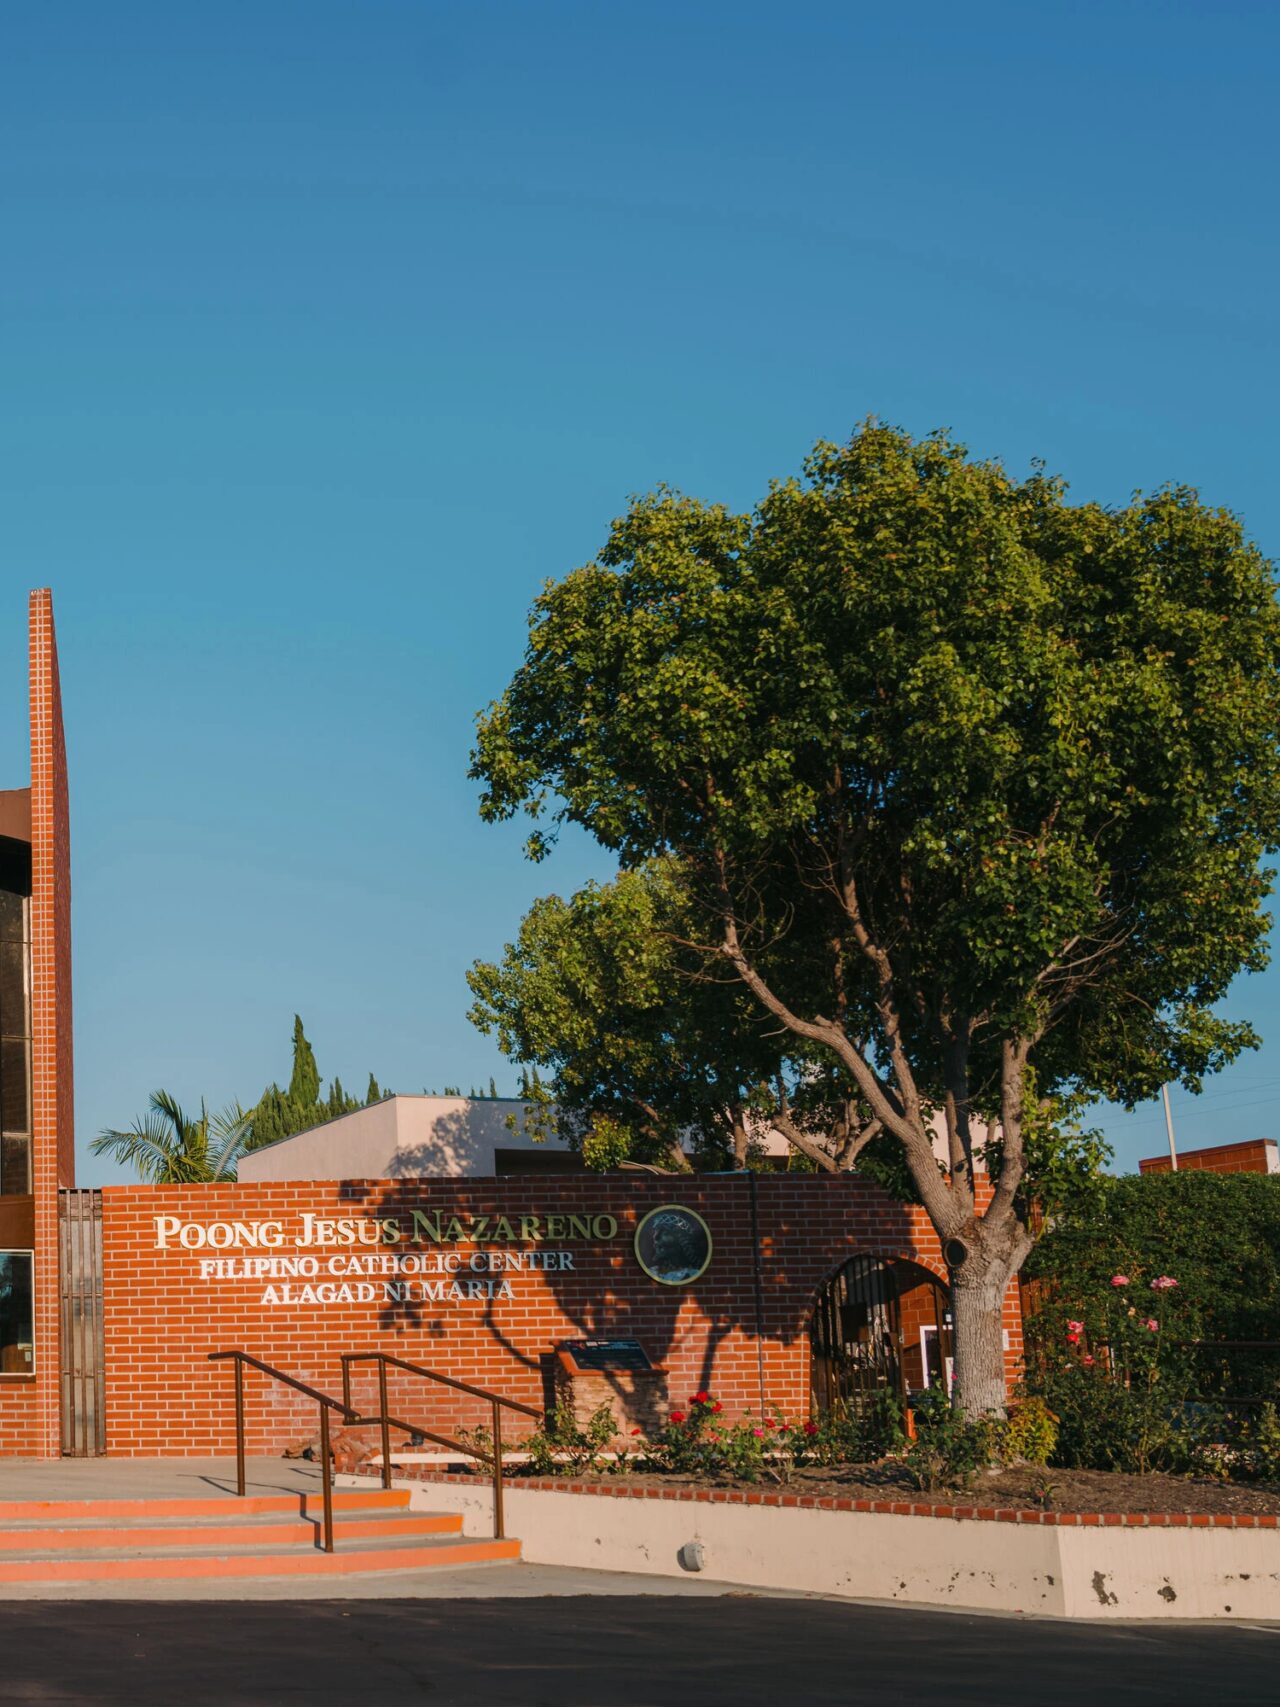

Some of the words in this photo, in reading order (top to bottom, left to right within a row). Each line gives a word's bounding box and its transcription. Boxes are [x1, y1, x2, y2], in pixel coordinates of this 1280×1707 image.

[153, 1216, 285, 1249] POONG
[295, 1213, 400, 1246] JESUS
[410, 1209, 618, 1243] NAZARENO
[199, 1256, 319, 1280] FILIPINO
[328, 1253, 462, 1276] CATHOLIC
[470, 1251, 576, 1273] CENTER
[260, 1282, 375, 1305] ALAGAD
[382, 1280, 414, 1302] NI
[420, 1279, 516, 1301] MARIA
